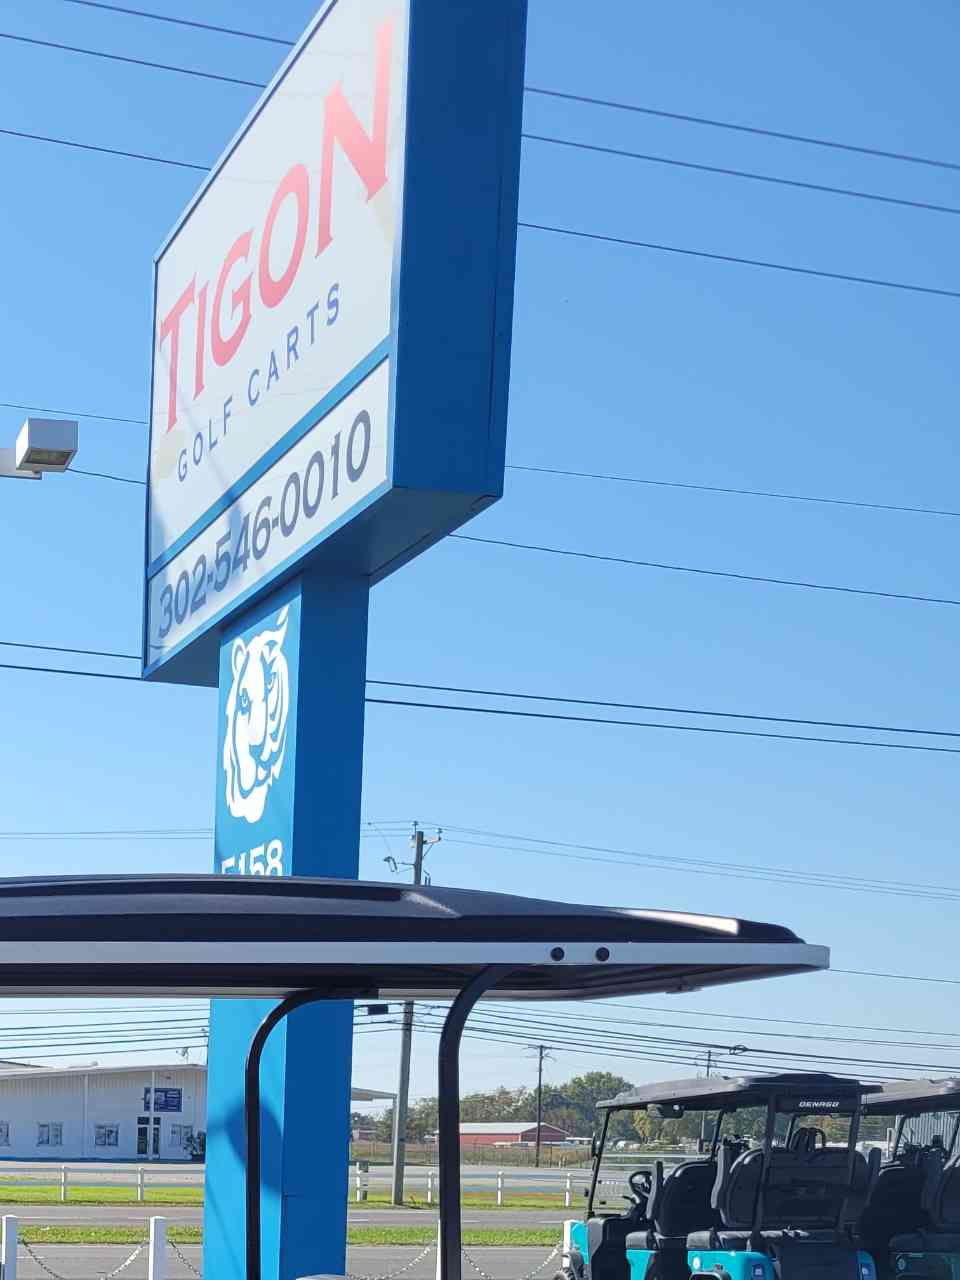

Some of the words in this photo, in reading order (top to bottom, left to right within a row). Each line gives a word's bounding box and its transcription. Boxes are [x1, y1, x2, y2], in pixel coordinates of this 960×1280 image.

[159, 15, 394, 434] TIGON
[177, 395, 233, 483] GOLF
[247, 282, 340, 407] CARTS
[158, 408, 372, 639] 302-546-0010
